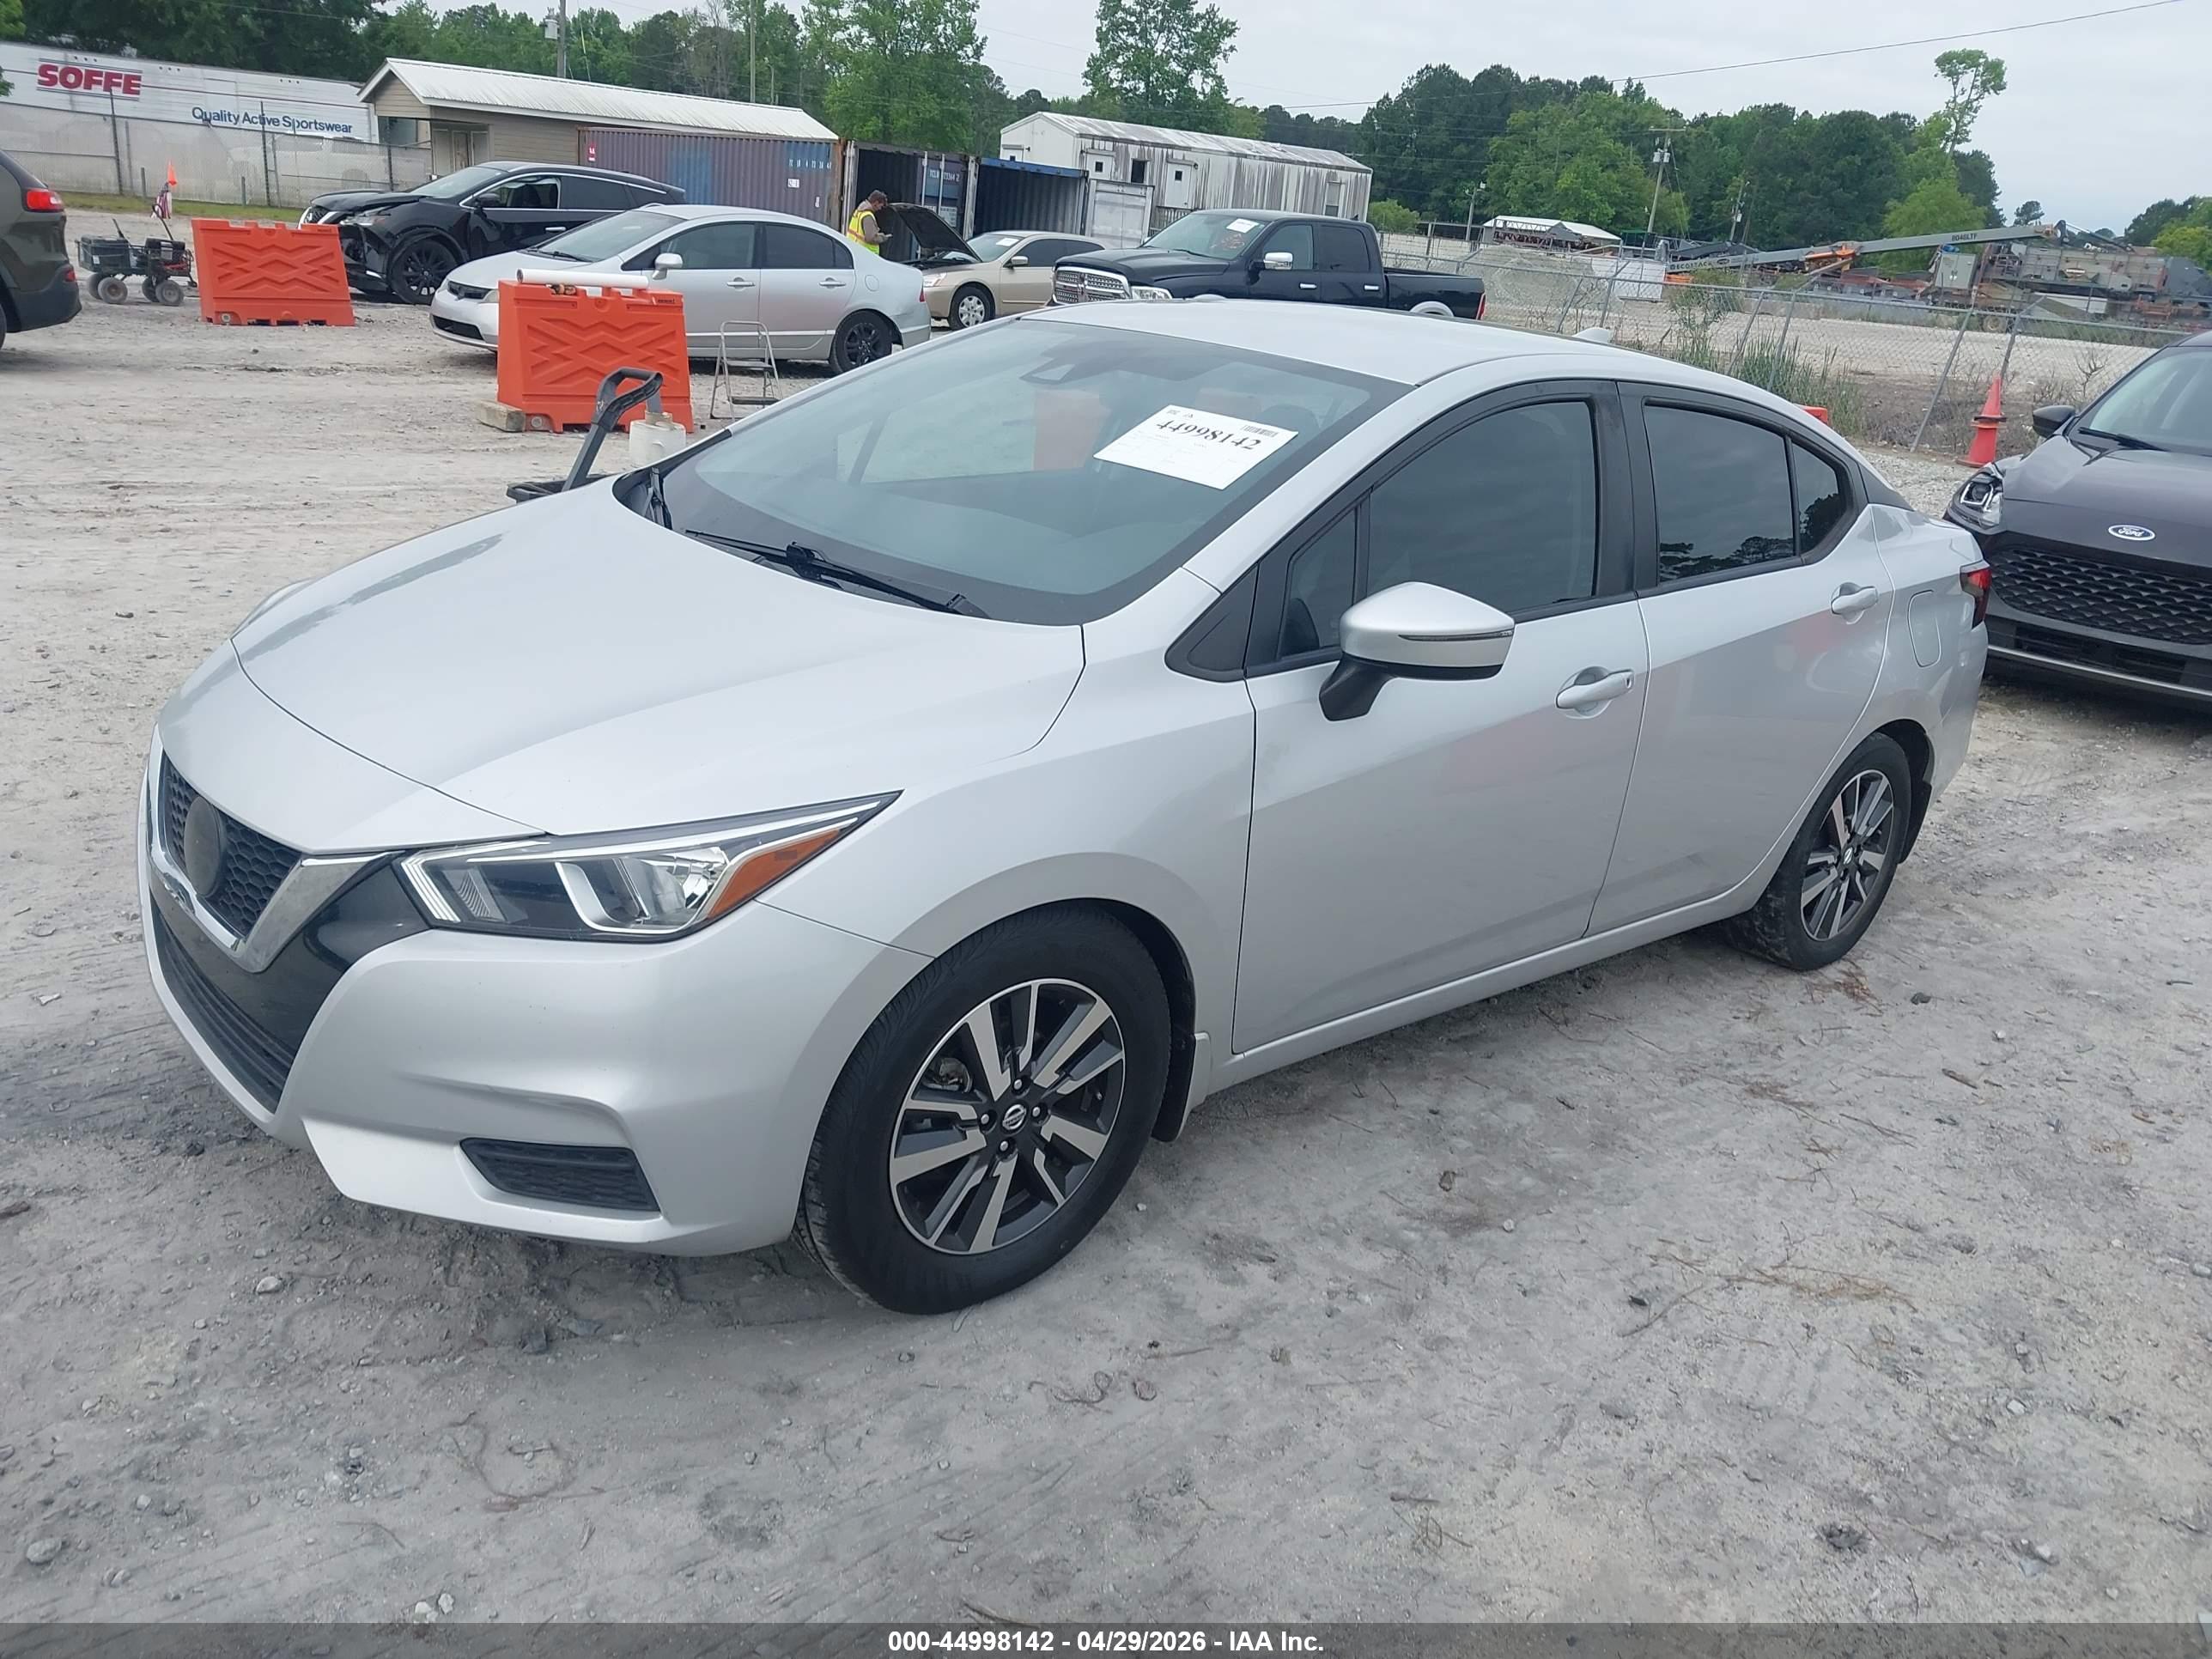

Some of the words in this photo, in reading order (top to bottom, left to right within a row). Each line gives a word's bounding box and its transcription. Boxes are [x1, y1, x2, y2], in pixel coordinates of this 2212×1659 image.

[38, 64, 142, 95] SOFFE
[192, 107, 240, 125] Quality
[242, 112, 280, 127] Active
[282, 115, 353, 133] Sportswear
[1157, 420, 1261, 450] 44998142
[2118, 526, 2145, 538] Ford
